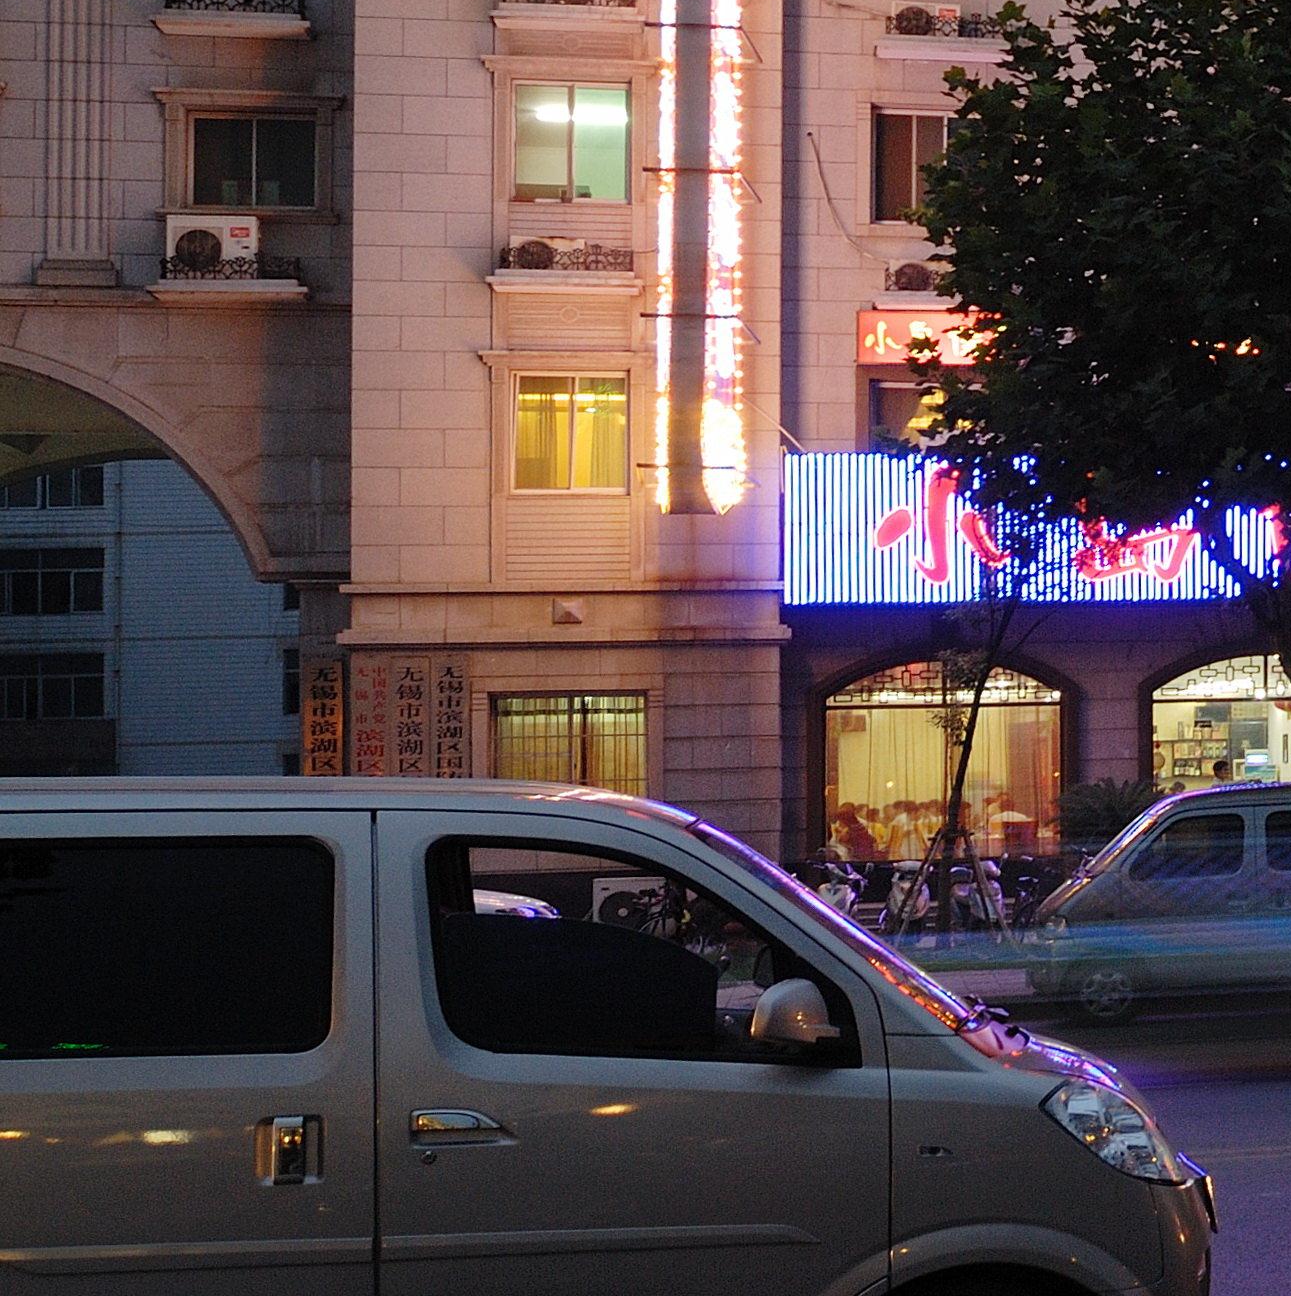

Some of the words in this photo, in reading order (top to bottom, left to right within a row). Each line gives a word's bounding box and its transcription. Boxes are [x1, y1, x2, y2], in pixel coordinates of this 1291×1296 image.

[309, 666, 339, 776] 无锡市滨湖区
[355, 728, 386, 777] 滨湖区
[396, 666, 424, 777] 无锡市滨湖区
